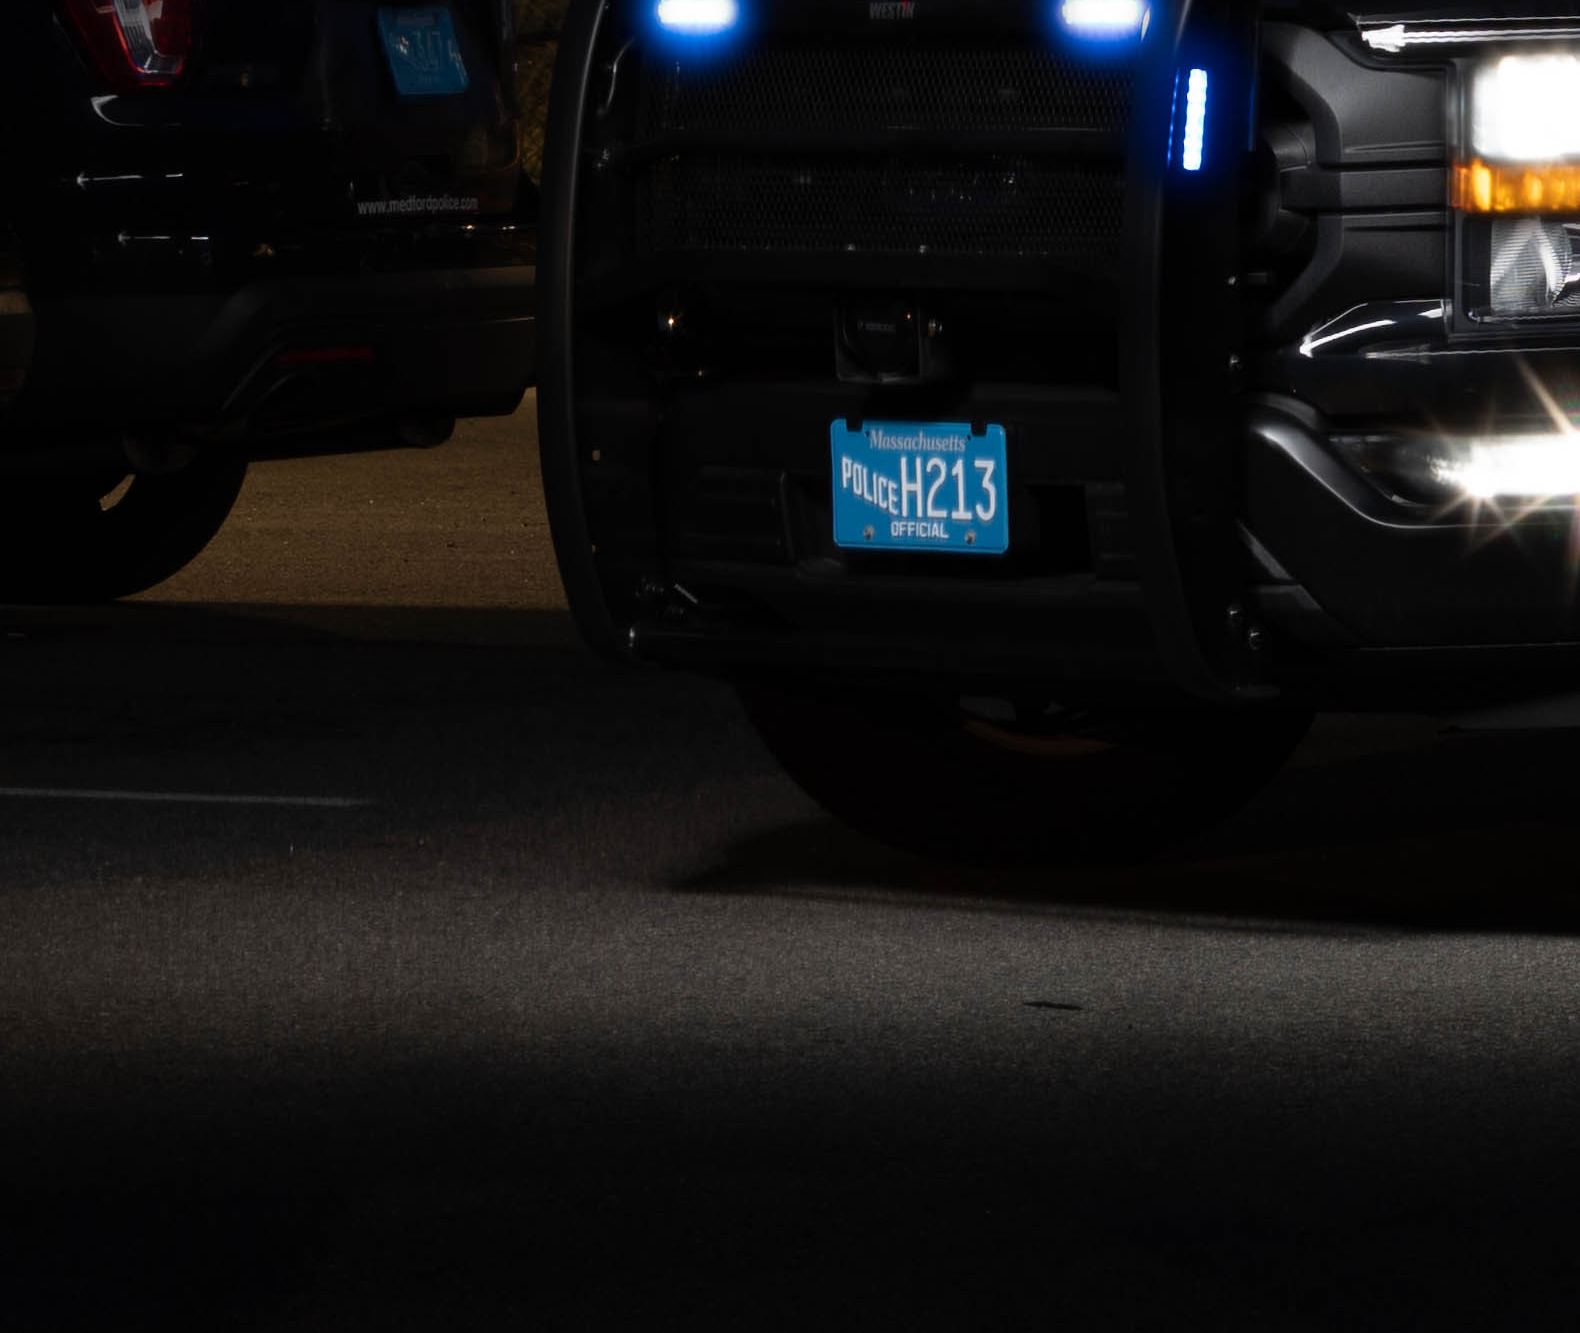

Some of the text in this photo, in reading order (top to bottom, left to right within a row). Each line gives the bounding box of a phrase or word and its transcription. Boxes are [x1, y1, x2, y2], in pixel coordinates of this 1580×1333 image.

[869, 429, 966, 452] Massachusetts
[841, 456, 996, 521] POLICE H213
[891, 520, 949, 539] OFFICIAL
